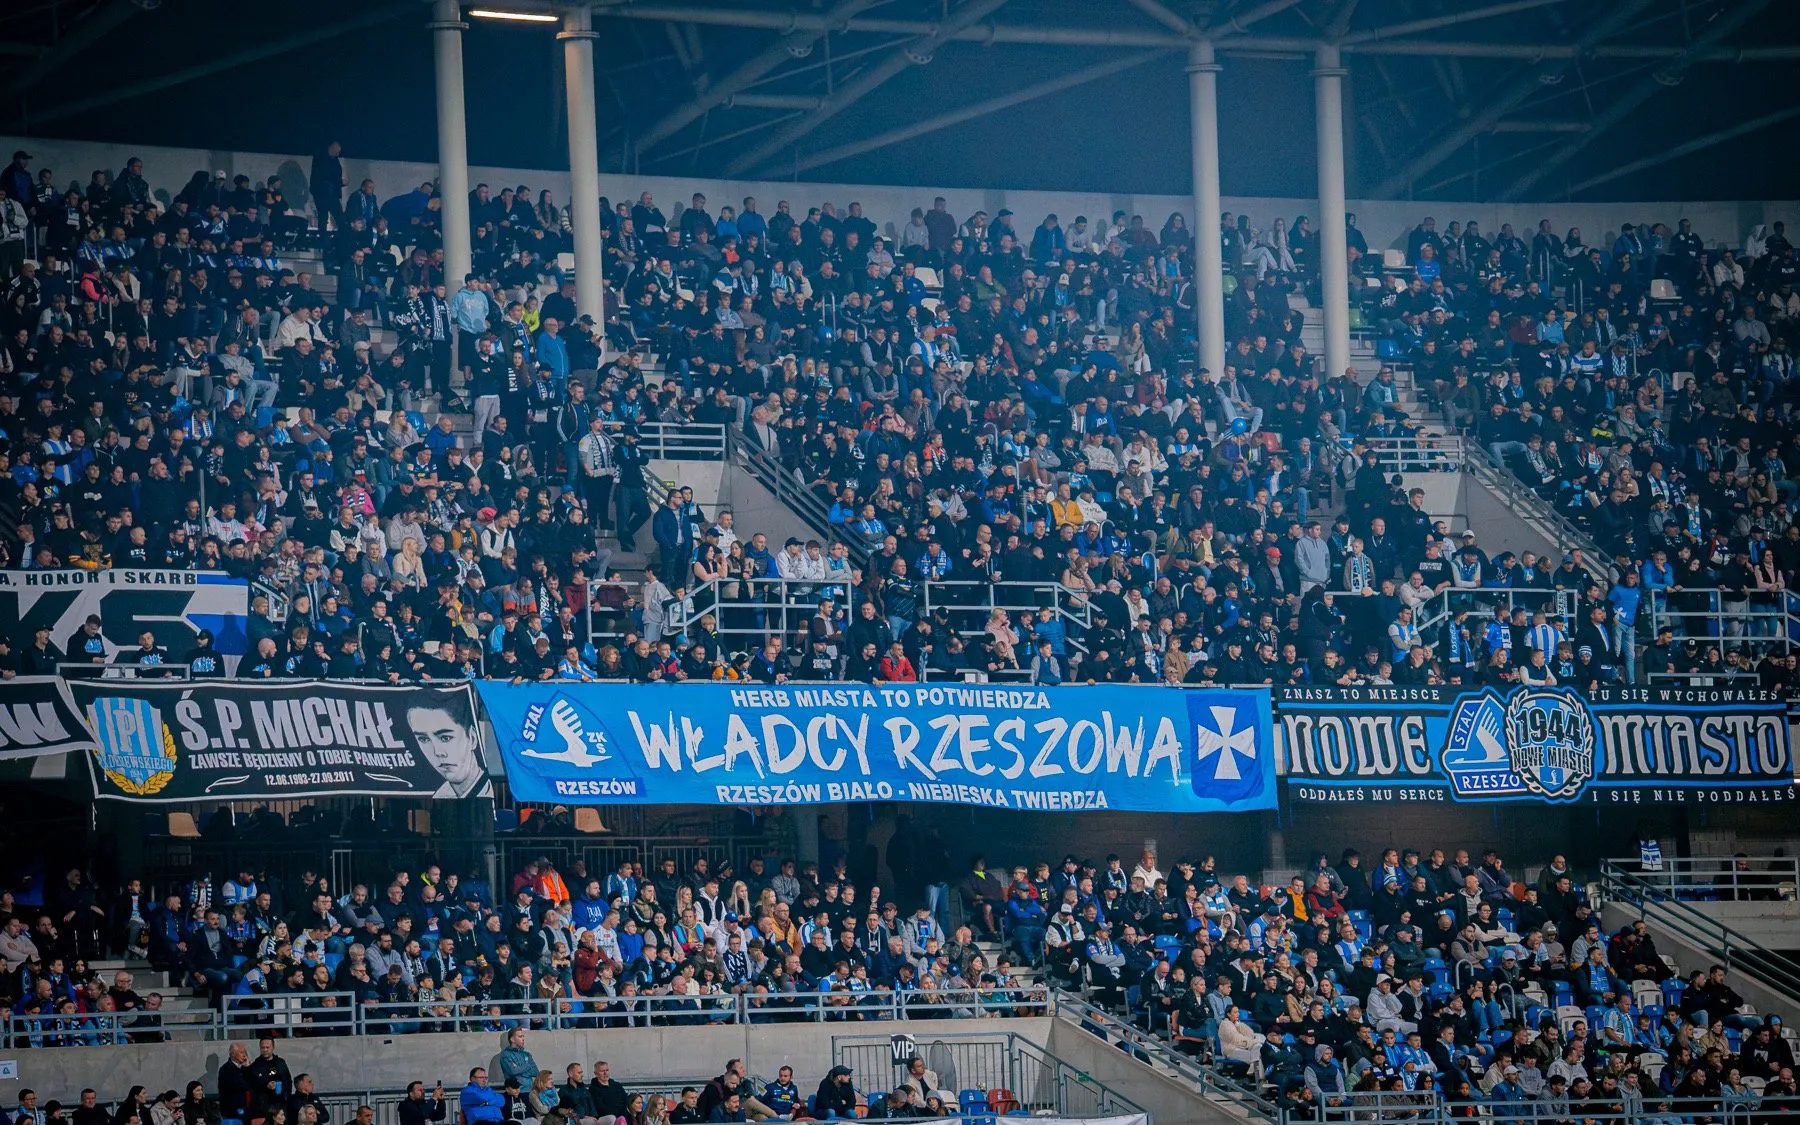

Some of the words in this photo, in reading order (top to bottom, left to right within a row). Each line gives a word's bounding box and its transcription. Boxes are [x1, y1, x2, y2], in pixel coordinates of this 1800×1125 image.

[25, 571, 100, 586] HONOR
[109, 572, 116, 584] I
[124, 571, 198, 585] SKARB
[730, 688, 791, 708] HERB
[797, 688, 878, 708] MIASTA
[880, 688, 910, 708] TO
[915, 687, 1051, 710] POTWIERDZA
[1283, 688, 1333, 699] ZNASZ
[1340, 688, 1360, 699] TO
[1368, 689, 1440, 700] MIEJSCE
[1589, 690, 1610, 700] TU
[1621, 688, 1650, 703] SIĘ
[175, 689, 251, 751] Ś.P.
[250, 697, 406, 749] MICHAŁ
[522, 703, 545, 742] STAL
[1455, 708, 1475, 746] STAL
[1514, 708, 1584, 748] 1944
[587, 731, 608, 743] ZK
[627, 709, 870, 780] WŁADCY
[883, 711, 1183, 787] RZESZOWA
[1283, 714, 1431, 775] NOWE
[1599, 715, 1787, 775] MIASTO
[188, 752, 242, 769] ZAWSZE
[244, 752, 303, 771] BĘDZIEMY
[307, 751, 315, 766] O
[317, 750, 353, 765] TOBIE
[354, 750, 416, 770] PAMIĘTAĆ
[1513, 746, 1545, 769] NOWE
[1548, 746, 1591, 774] MIASTO
[555, 777, 637, 795] RZESZÓW
[715, 780, 820, 803] RZESZÓW
[827, 781, 893, 801] BIAŁO
[907, 782, 1008, 807] NIEBIESKA
[1011, 789, 1109, 810] TWIERDZA
[1300, 787, 1364, 801] ODDAŁEŚ
[1372, 789, 1392, 801] MU
[1400, 789, 1444, 801] SERCE
[1593, 791, 1598, 801] I
[1611, 790, 1641, 804] SIĘ
[1654, 790, 1685, 801] NIE
[1697, 786, 1796, 802] PODDAŁEŚ
[891, 1040, 915, 1059] VIP
